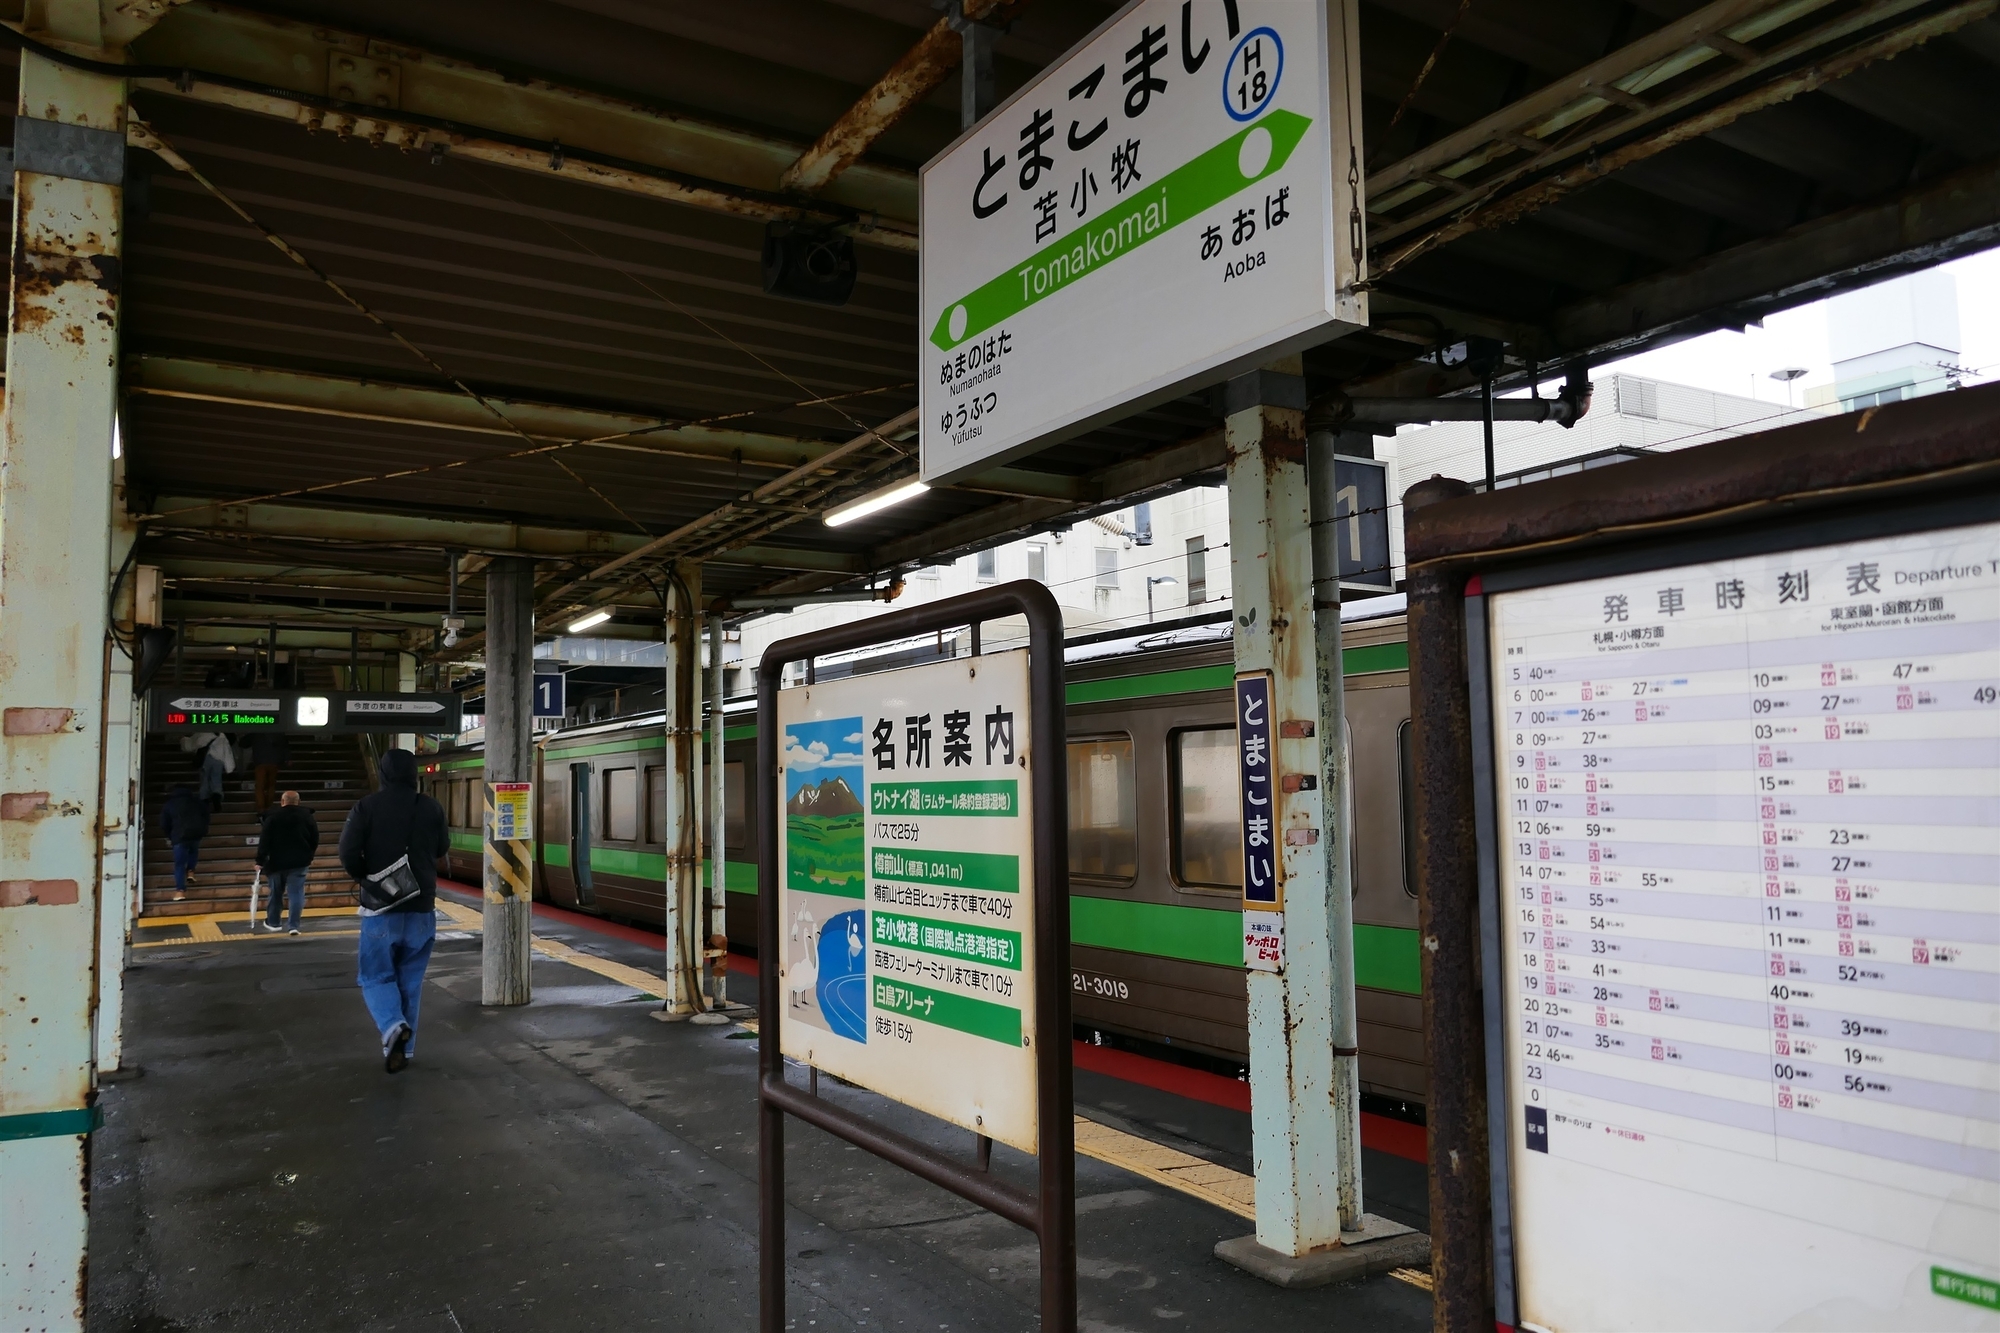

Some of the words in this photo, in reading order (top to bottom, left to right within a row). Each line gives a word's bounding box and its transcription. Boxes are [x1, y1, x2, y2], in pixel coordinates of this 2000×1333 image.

[1243, 39, 1262, 76] H
[1237, 70, 1268, 111] 18
[972, 0, 1241, 219] とまこまい
[1034, 138, 1142, 244] 苫小牧
[1200, 186, 1291, 261] あおば
[1018, 187, 1169, 302] Tomakomai
[1224, 250, 1267, 283] Aoba
[940, 329, 1013, 386] ぬまのはた
[949, 364, 1002, 398] Numanohata
[940, 392, 998, 435] ゆうふつ
[951, 424, 984, 447] Yūfutsu
[1336, 485, 1361, 562] 1
[1603, 561, 1881, 624] 発車時刻表
[1894, 564, 1982, 585] Departure
[1512, 668, 1520, 680] 5
[1530, 667, 1543, 680] 40
[1753, 673, 1770, 688] 10
[1892, 663, 1912, 679] 47
[538, 680, 551, 710] 1
[1514, 690, 1521, 702] 6
[1530, 689, 1544, 702] 00
[1632, 682, 1648, 695] 27
[1753, 698, 1772, 714] 09
[1821, 695, 1840, 711] 27
[1974, 686, 1996, 704] 49
[168, 714, 186, 724] LTD
[191, 713, 229, 724] 11:45
[234, 714, 275, 724] Hakodate
[1514, 712, 1522, 724] 7
[1532, 712, 1545, 724] 00
[1581, 708, 1596, 722] 26
[871, 704, 1015, 771] 名所案内
[1516, 734, 1524, 746] 8
[1532, 734, 1546, 746] 09
[1582, 732, 1596, 744] 27
[1754, 724, 1773, 740] 03
[1516, 756, 1525, 768] 9
[1582, 754, 1598, 768] 38
[1244, 694, 1272, 887] とまこまい
[1516, 777, 1529, 790] 10
[1759, 776, 1776, 790] 15
[1517, 800, 1528, 812] 11
[1536, 800, 1549, 812] 07
[873, 822, 920, 842] バスで25分
[1518, 821, 1530, 834] 12
[1536, 822, 1550, 835] 06
[1586, 824, 1600, 836] 59
[1830, 830, 1850, 844] 23
[1518, 844, 1532, 856] 13
[1832, 856, 1851, 872] 27
[1520, 865, 1532, 878] 14
[1538, 867, 1552, 880] 07
[1642, 873, 1658, 886] 55
[1520, 888, 1534, 900] 15
[1590, 894, 1604, 906] 55
[1522, 910, 1534, 922] 16
[1590, 916, 1605, 930] 54
[1768, 906, 1781, 921] 11
[1251, 923, 1272, 933] 本場の味
[1245, 934, 1279, 949] サッポロ
[1522, 932, 1536, 944] 17
[1591, 940, 1606, 954] 33
[1769, 932, 1782, 947] 11
[1258, 948, 1280, 962] ビール
[1524, 954, 1536, 966] 18
[1592, 964, 1605, 977] 41
[1838, 966, 1858, 982] 52
[1524, 976, 1538, 990] 19
[1594, 986, 1608, 1000] 28
[1770, 985, 1789, 1000] 40
[875, 982, 935, 1016] 白鳥アリーナ
[1524, 998, 1540, 1012] 20
[1545, 1002, 1558, 1016] 23
[875, 1015, 914, 1044] 徒歩15分
[1526, 1020, 1538, 1034] 21
[1546, 1025, 1560, 1038] 07
[1595, 1034, 1610, 1048] 35
[1841, 1020, 1861, 1036] 39
[1526, 1043, 1541, 1058] 22
[1546, 1048, 1561, 1062] 46
[1844, 1048, 1862, 1064] 19
[1526, 1066, 1542, 1080] 23
[1774, 1064, 1794, 1080] 00
[1844, 1075, 1864, 1093] 56
[1532, 1088, 1540, 1102] 0
